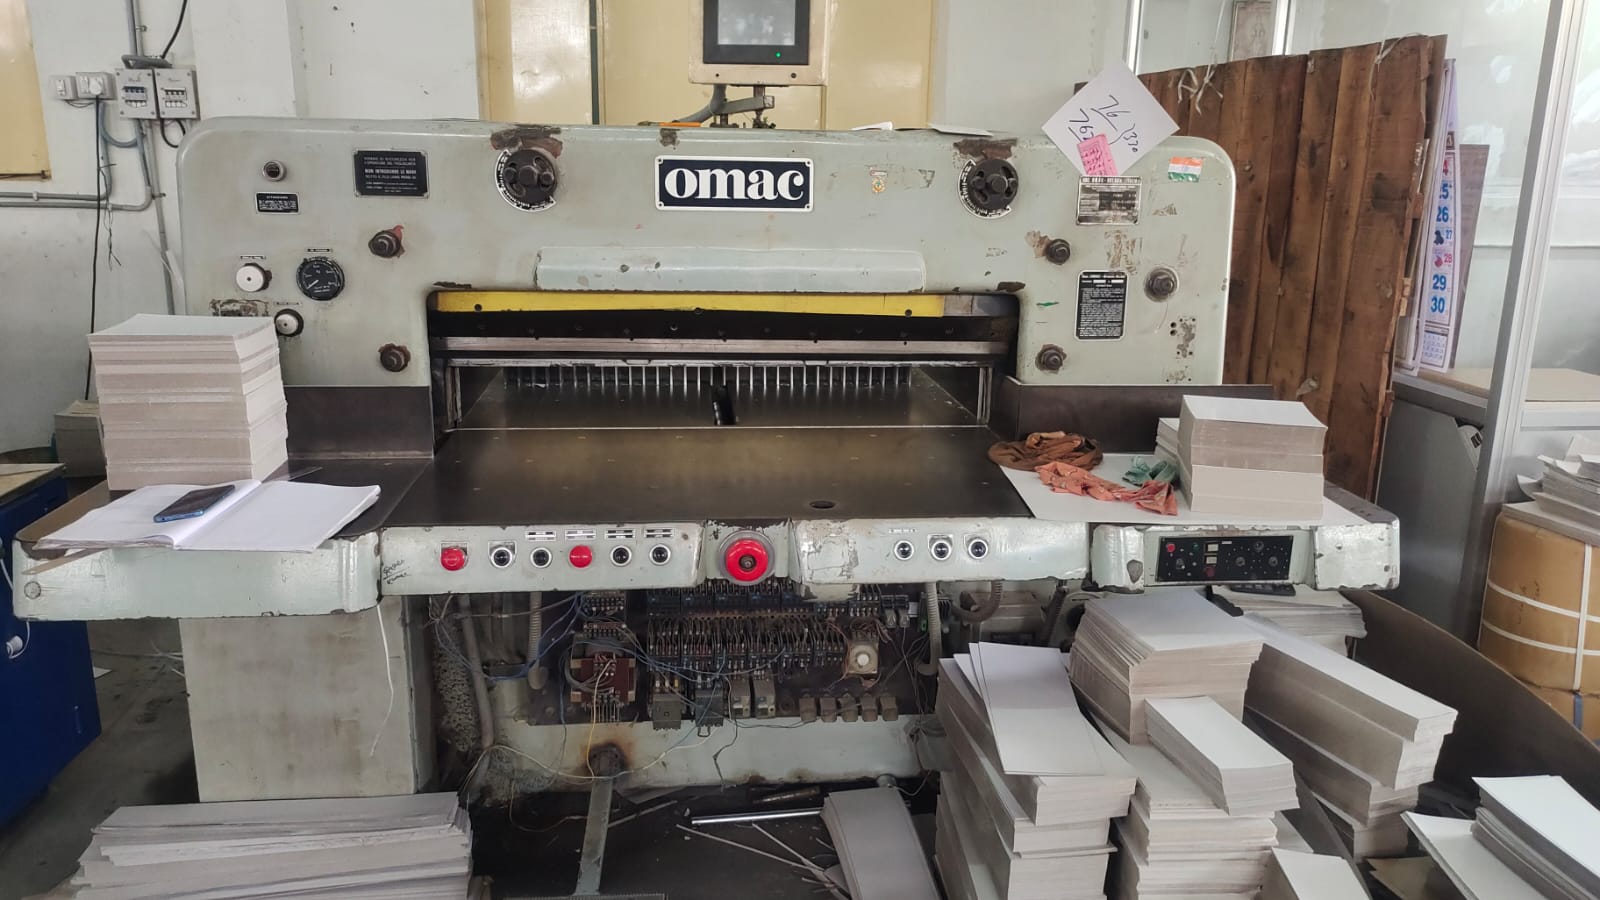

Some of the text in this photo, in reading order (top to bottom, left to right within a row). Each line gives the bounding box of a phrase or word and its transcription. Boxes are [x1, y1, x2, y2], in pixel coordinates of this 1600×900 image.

[1099, 94, 1131, 117] 76
[665, 168, 804, 201] omac
[1440, 183, 1450, 199] 5
[1436, 206, 1450, 223] 26
[1446, 230, 1453, 240] 27
[1444, 254, 1453, 263] 28
[1432, 274, 1447, 291] 29
[1431, 296, 1445, 314] 30
